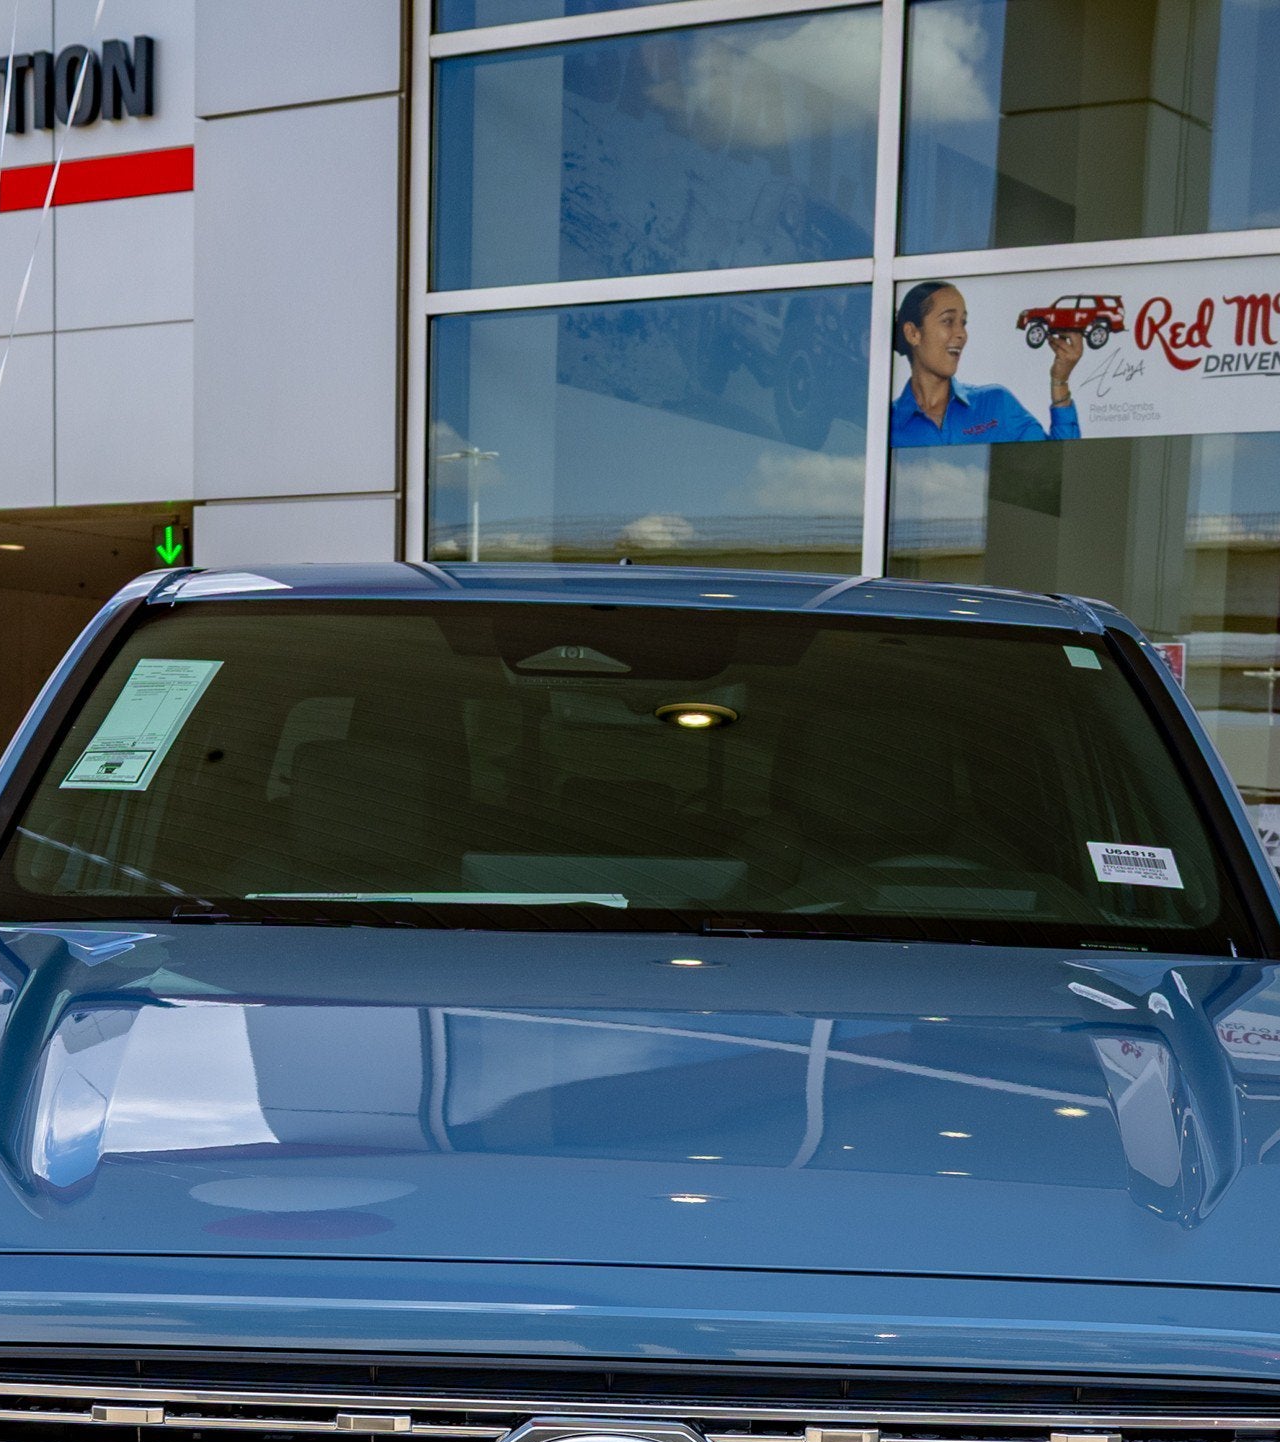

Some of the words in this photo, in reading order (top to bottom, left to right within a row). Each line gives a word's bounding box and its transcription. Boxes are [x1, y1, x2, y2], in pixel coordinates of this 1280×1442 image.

[1135, 297, 1214, 371] Red
[1090, 404, 1107, 412] Red
[1089, 412, 1131, 422] Universal
[1133, 411, 1161, 422] Toyota
[1105, 848, 1156, 858] U64918
